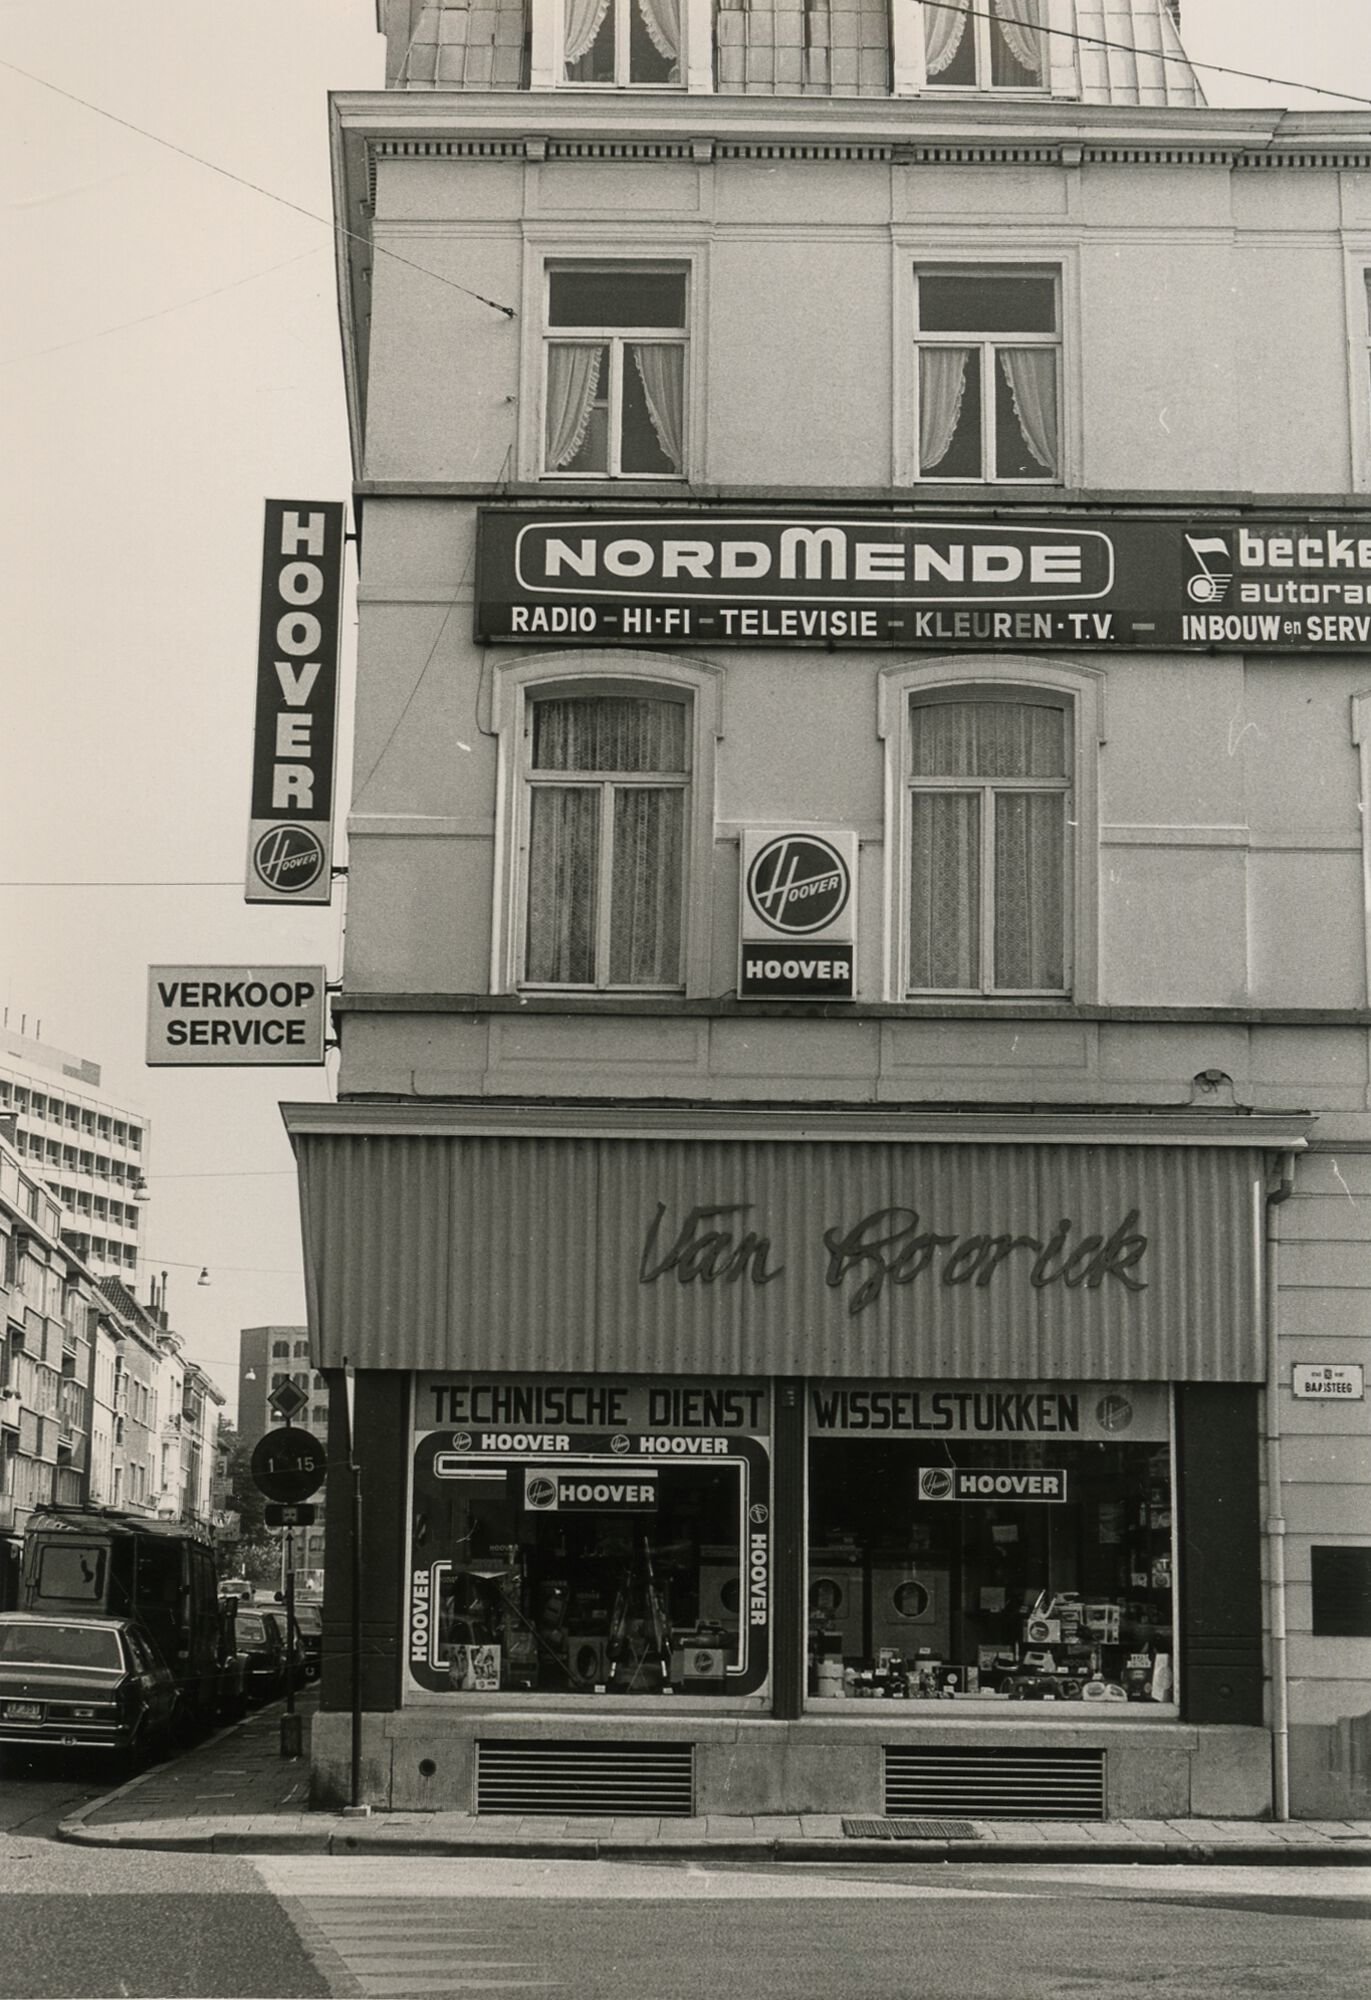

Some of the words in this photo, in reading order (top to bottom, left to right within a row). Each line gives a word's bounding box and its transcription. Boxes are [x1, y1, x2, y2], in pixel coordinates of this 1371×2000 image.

[545, 527, 1082, 581] NORDMENDE
[1241, 581, 1371, 604] autora
[511, 606, 598, 632] RADIO
[720, 610, 878, 637] TELEVISIE
[915, 612, 1052, 638] KLEUREN
[1181, 615, 1281, 641] INBOUW
[1283, 621, 1302, 635] en
[271, 510, 326, 810] HOOVER
[746, 960, 850, 979] HOOVER
[158, 982, 314, 1007] VERKOOP
[166, 1020, 306, 1045] SERVICE
[431, 1386, 628, 1426] TECHNISCHE
[650, 1389, 764, 1428] DIENST
[813, 1390, 1079, 1433] WISSELSTUKKEN
[481, 1434, 570, 1451] HOOVER
[640, 1437, 728, 1454] HOOVER
[296, 1457, 315, 1473] 15
[559, 1484, 656, 1503] HOOVER
[960, 1476, 1059, 1494] HOOVER
[751, 1534, 767, 1626] HOOVER
[411, 1569, 430, 1662] HOOVER
